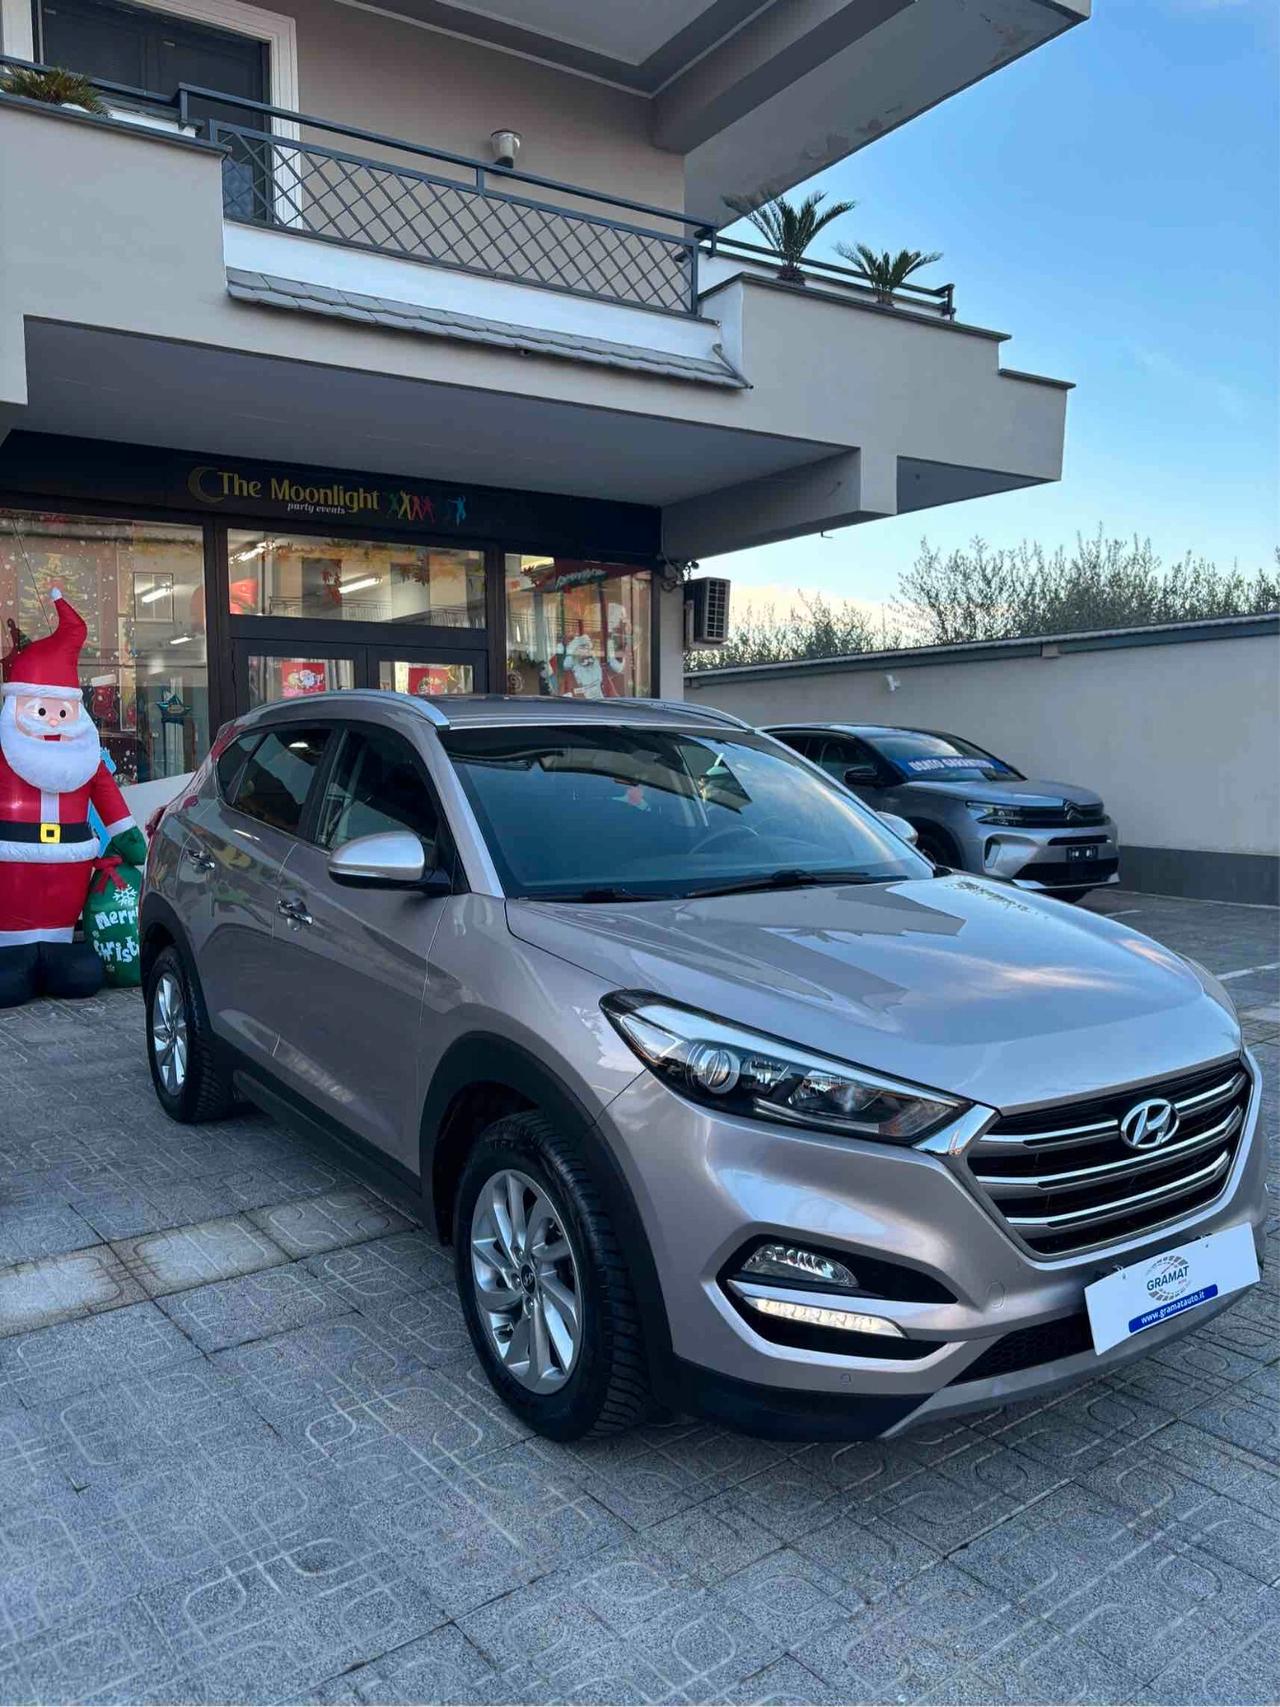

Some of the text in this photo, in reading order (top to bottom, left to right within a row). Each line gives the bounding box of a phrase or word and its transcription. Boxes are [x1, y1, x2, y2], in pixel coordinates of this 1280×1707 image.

[217, 471, 381, 513] The Moonlight
[287, 501, 346, 515] party events
[95, 906, 139, 930] Merr
[1146, 1265, 1190, 1292] GRAMAT
[1140, 1291, 1206, 1325] www.gramatauto.it
